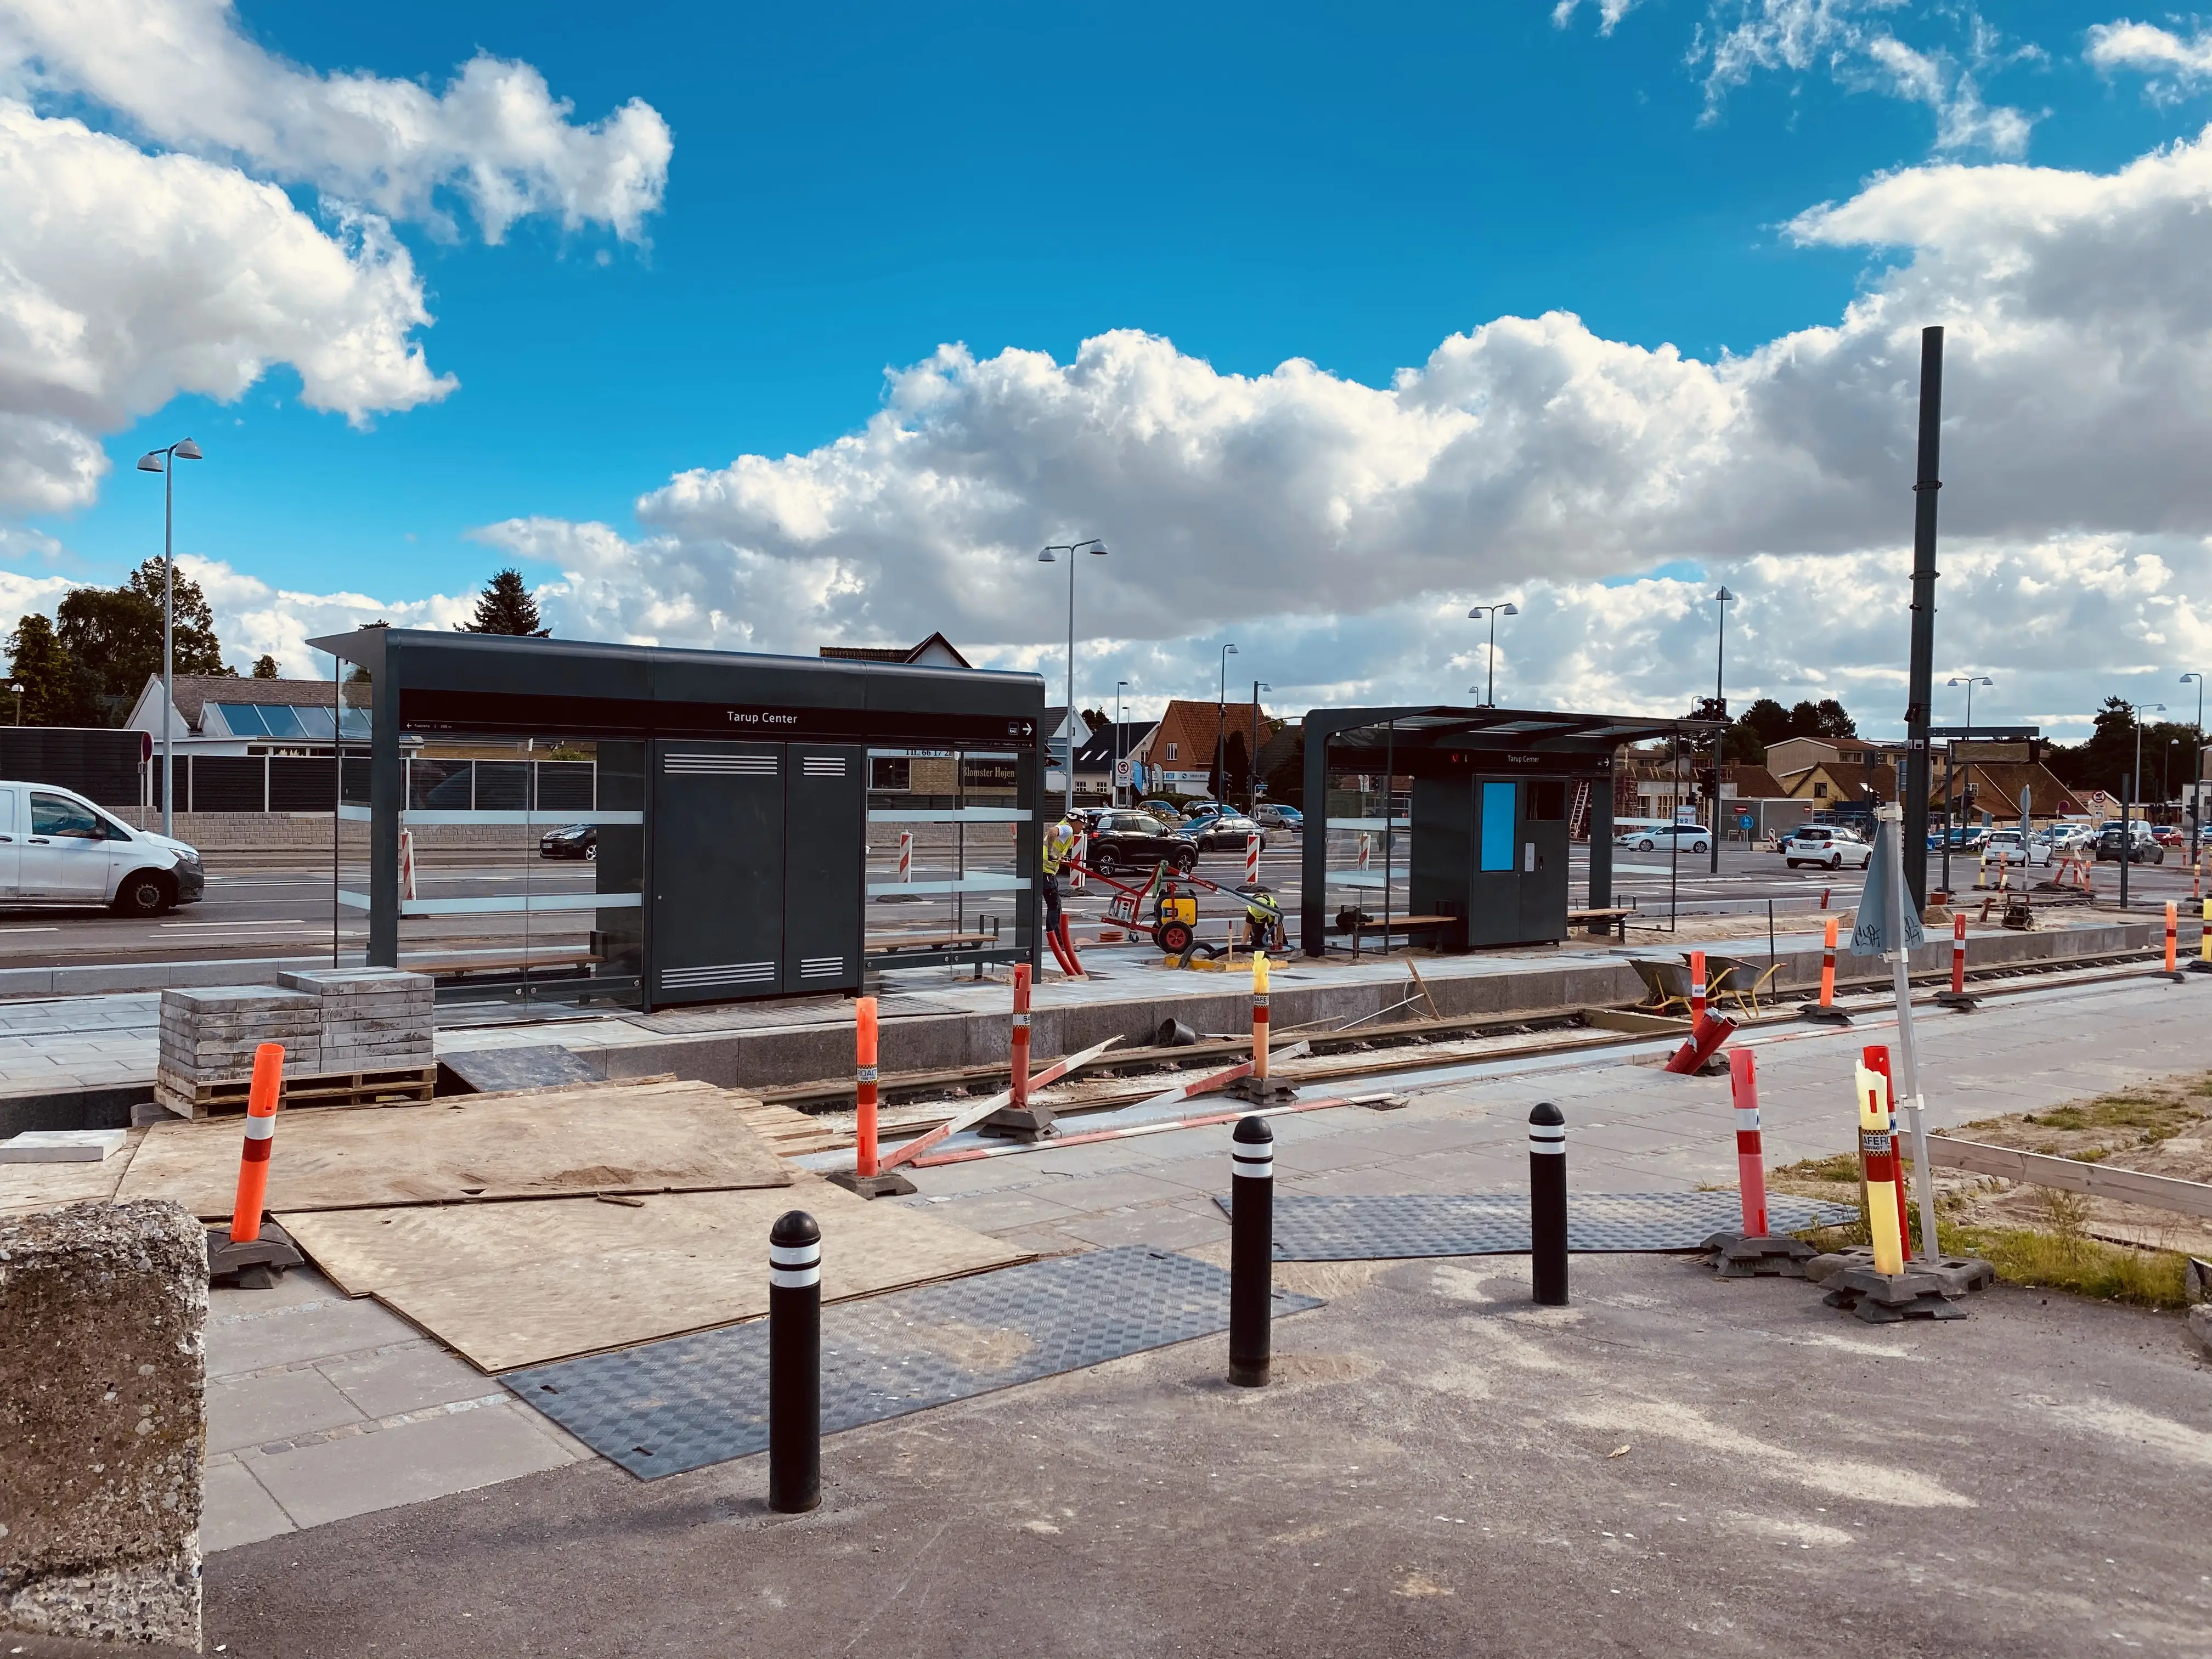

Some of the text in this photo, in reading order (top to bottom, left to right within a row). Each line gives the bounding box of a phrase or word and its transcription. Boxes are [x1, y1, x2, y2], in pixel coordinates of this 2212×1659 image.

[727, 711, 797, 724] Tarup Center
[1507, 755, 1522, 763] Tarup
[963, 766, 1015, 779] Blomster Højen
